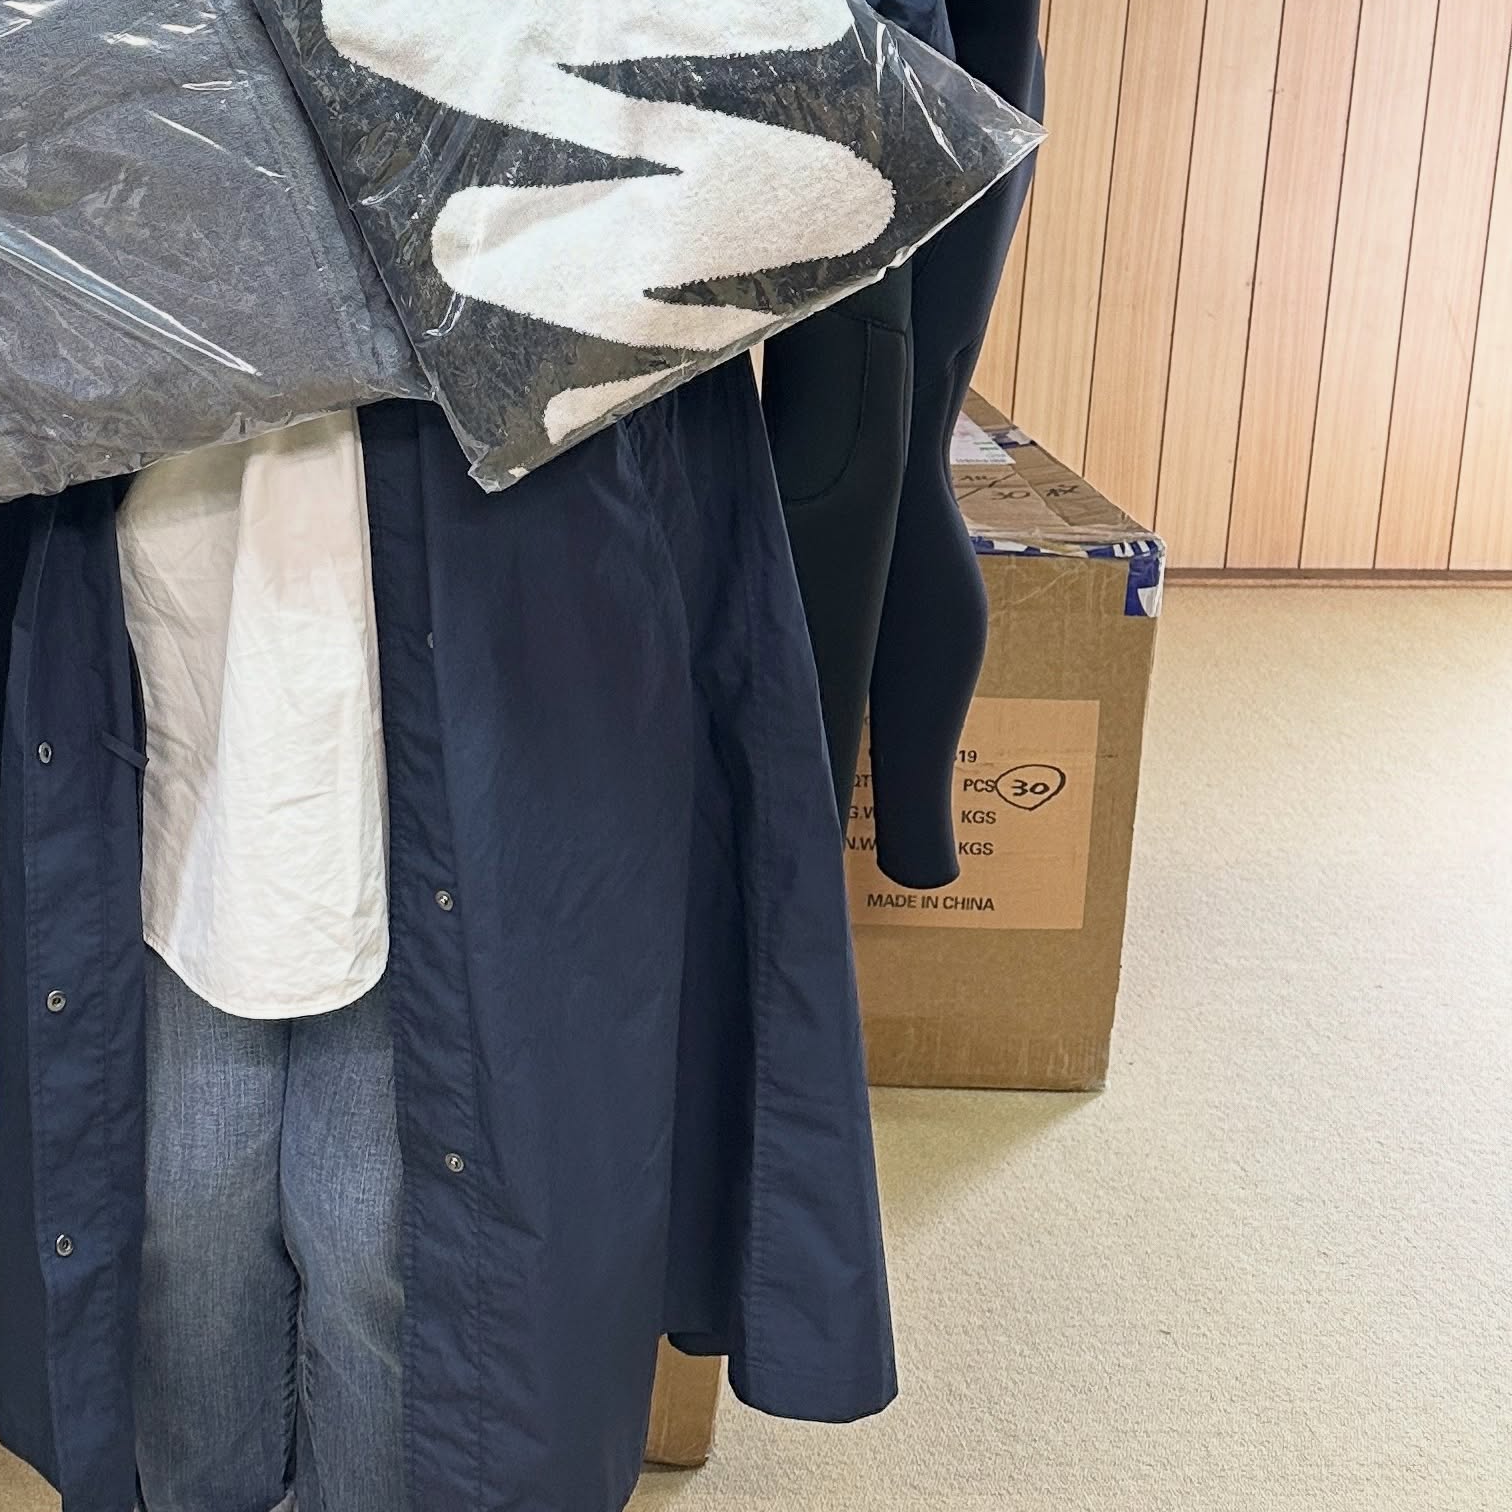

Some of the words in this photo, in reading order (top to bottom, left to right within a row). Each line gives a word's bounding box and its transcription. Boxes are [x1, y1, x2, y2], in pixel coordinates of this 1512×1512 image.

[955, 749, 978, 763] 19
[963, 778, 996, 793] PCS
[1011, 779, 1050, 797] 30
[960, 809, 997, 825] KGS
[958, 841, 994, 856] KGS
[867, 893, 918, 908] MADE
[921, 895, 939, 909] IN
[942, 895, 995, 911] CHINA
